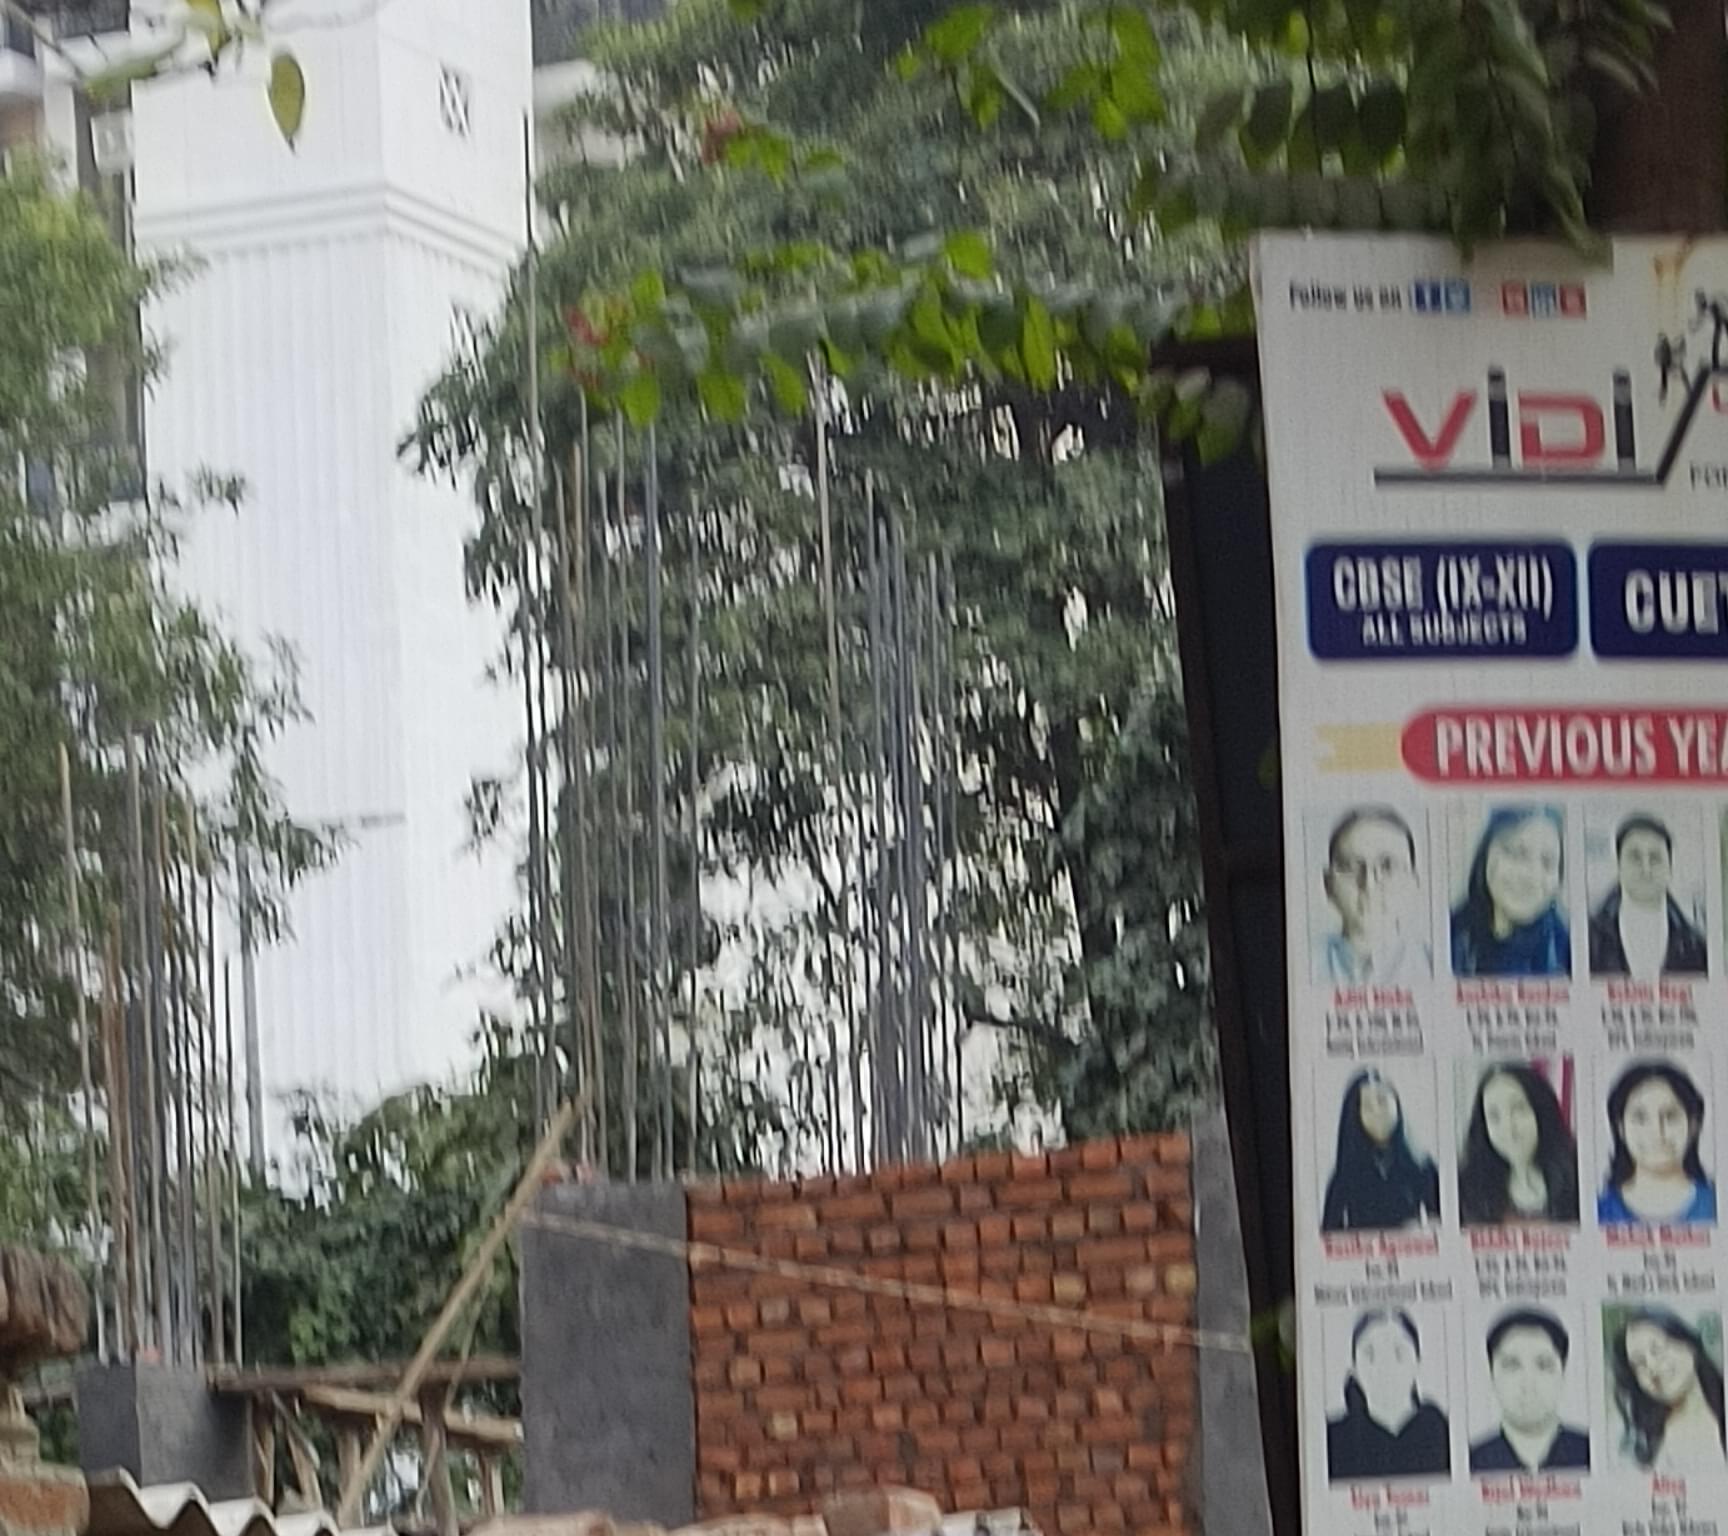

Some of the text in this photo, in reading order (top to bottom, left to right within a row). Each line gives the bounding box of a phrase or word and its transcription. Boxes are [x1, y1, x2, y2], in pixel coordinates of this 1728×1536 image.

[1332, 553, 1553, 622] CBSE (IX-XII)
[1362, 611, 1527, 647] ALL SUBJECTS
[1436, 713, 1657, 778] PREVIOUS
